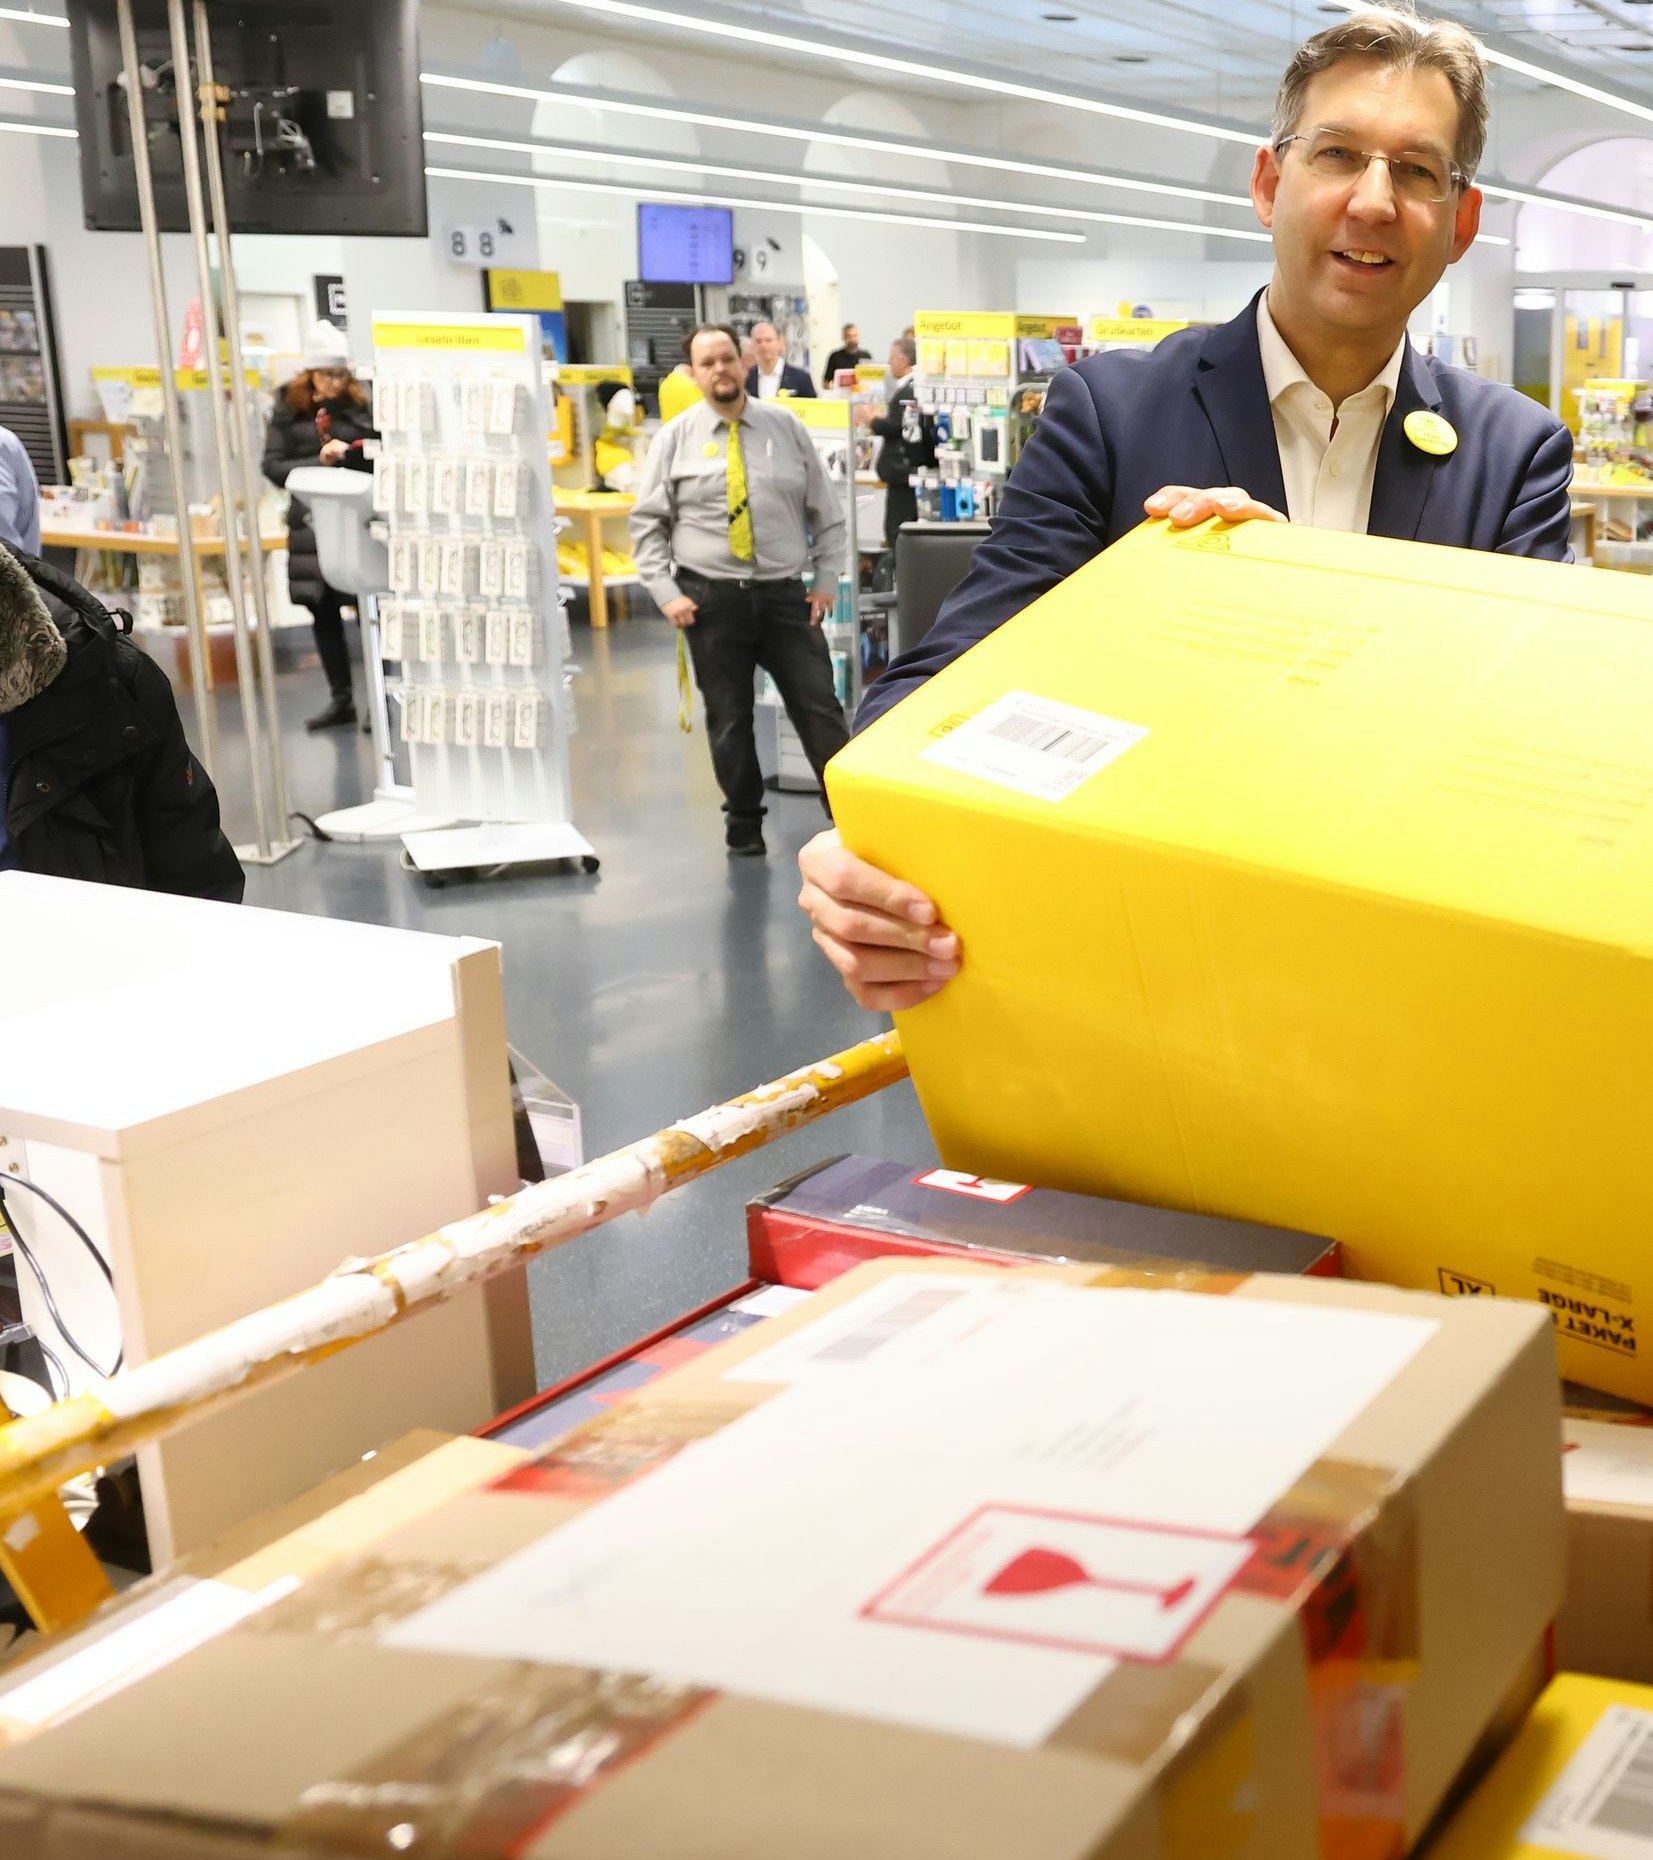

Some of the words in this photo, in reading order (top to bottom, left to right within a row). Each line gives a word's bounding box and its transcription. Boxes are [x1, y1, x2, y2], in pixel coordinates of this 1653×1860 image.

[452, 231, 466, 256] 8
[1537, 1287, 1634, 1332] X-LARGE
[1566, 1316, 1637, 1351] PAKET
